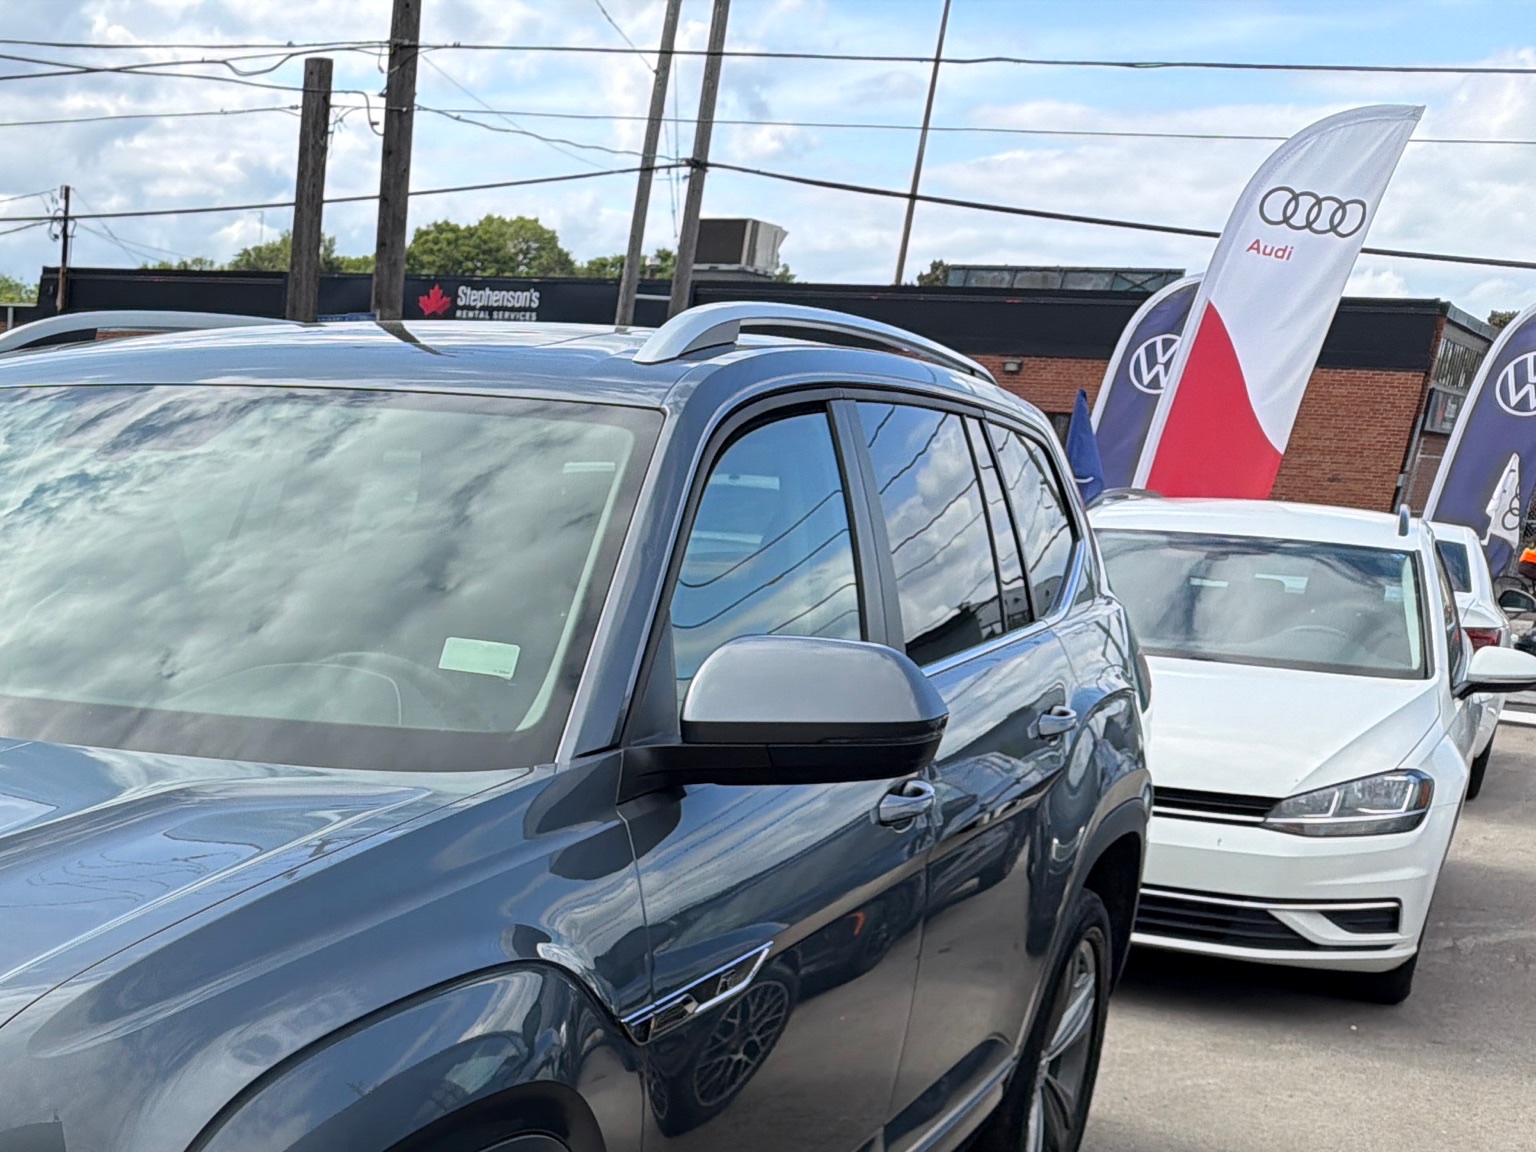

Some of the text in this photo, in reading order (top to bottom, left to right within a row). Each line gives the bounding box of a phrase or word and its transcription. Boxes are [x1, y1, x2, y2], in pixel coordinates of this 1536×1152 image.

[1246, 239, 1294, 261] Audi
[457, 285, 540, 309] Stephenson's
[455, 309, 537, 320] RENTAL SERVICES
